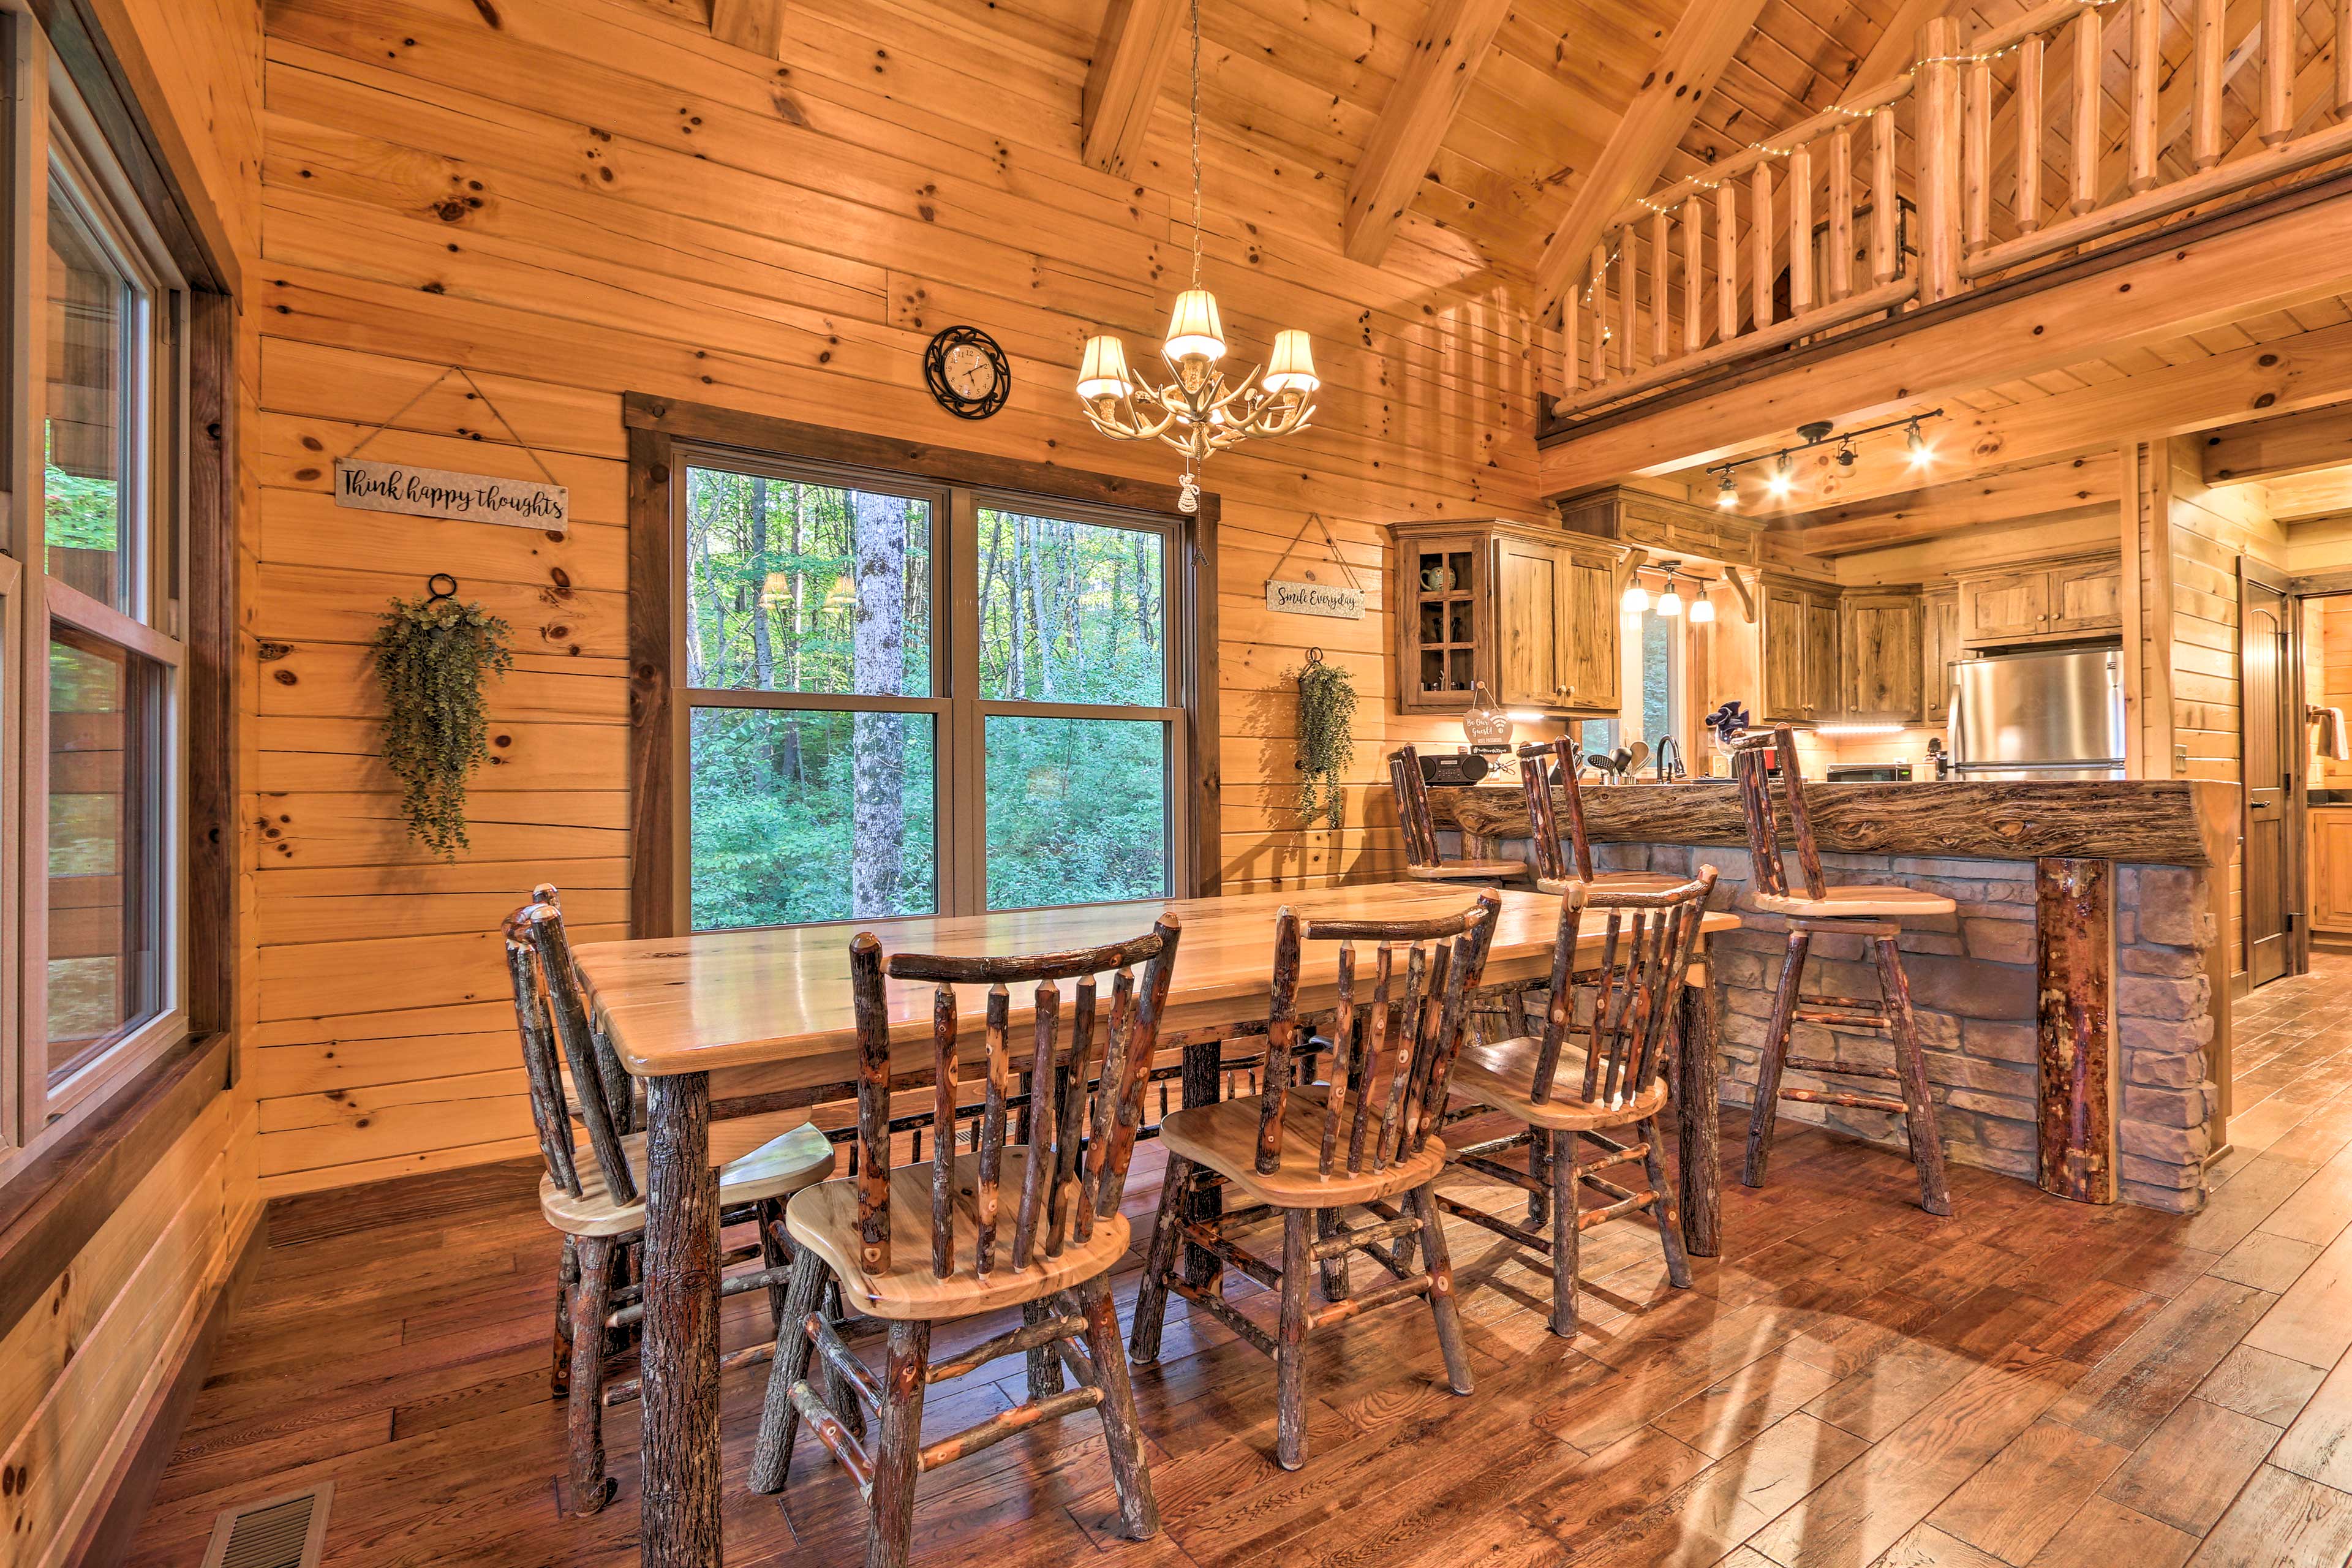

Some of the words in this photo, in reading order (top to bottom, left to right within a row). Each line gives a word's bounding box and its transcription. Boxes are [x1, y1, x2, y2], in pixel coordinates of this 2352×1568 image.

[341, 469, 404, 500] Think
[407, 476, 475, 511] happy
[475, 485, 564, 519] thoughts
[1278, 587, 1307, 606] Smile
[1310, 590, 1356, 611] Everyday
